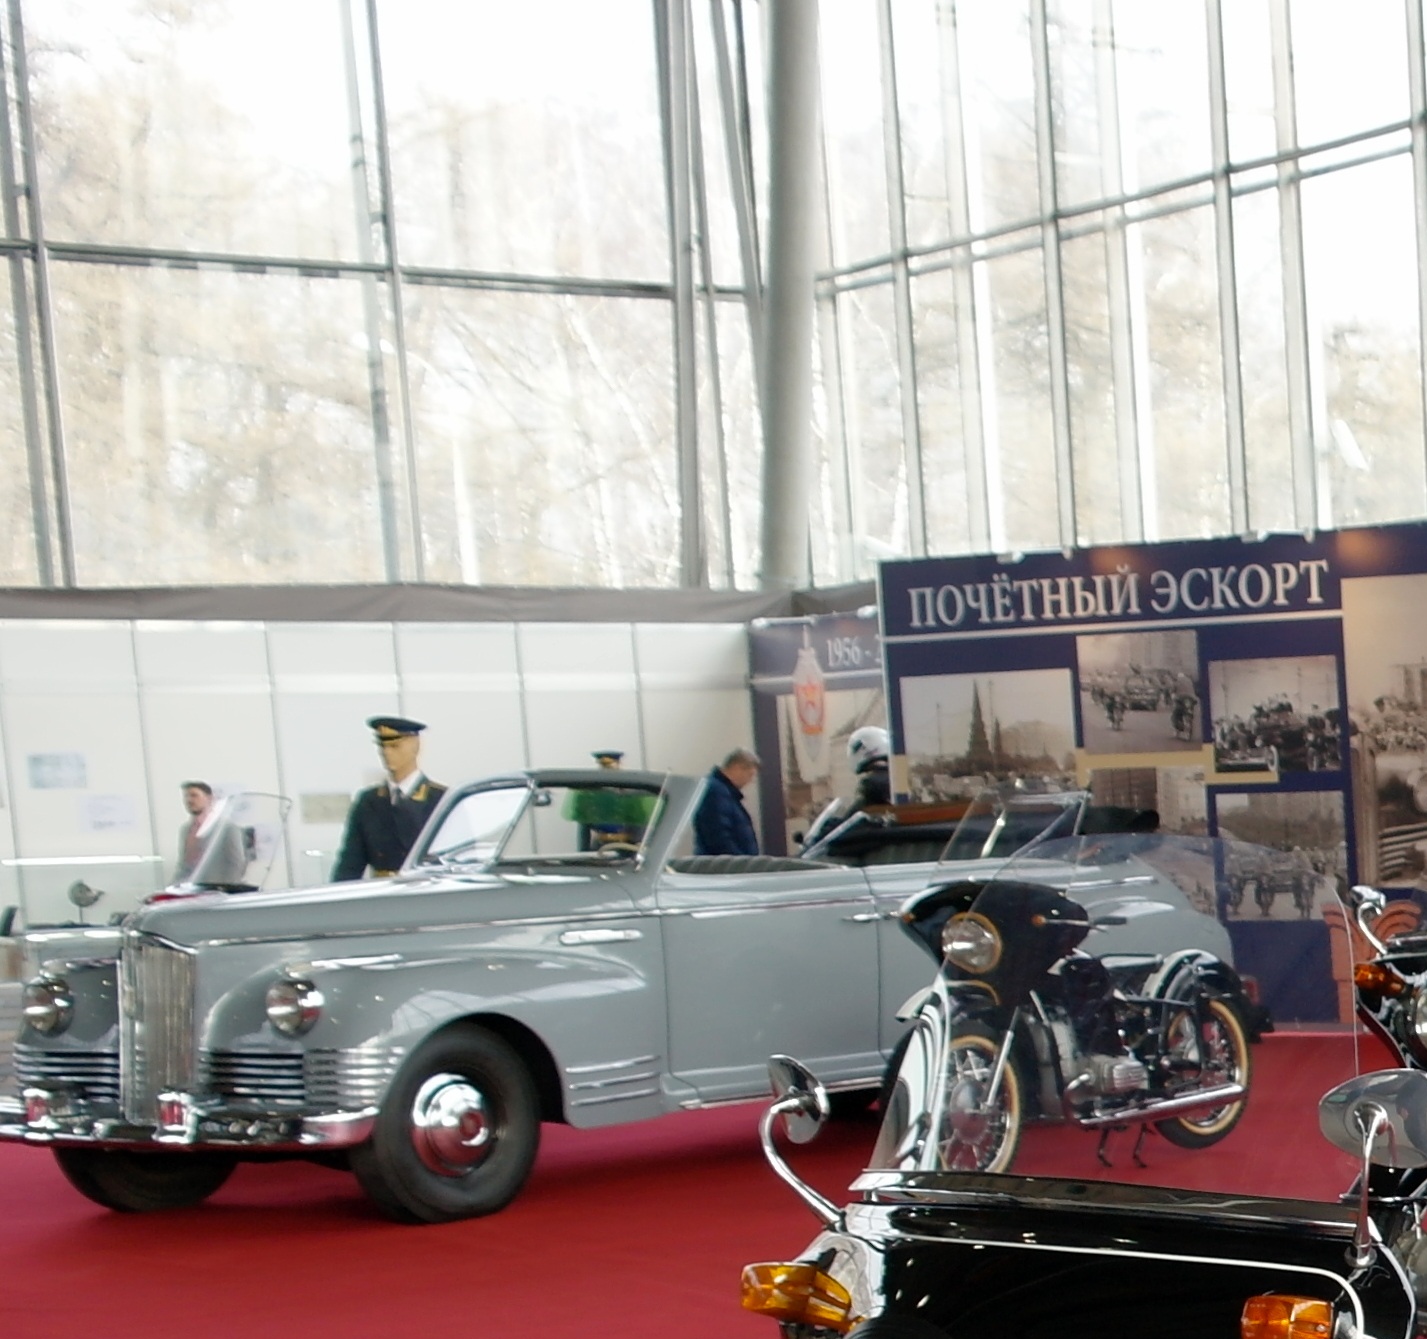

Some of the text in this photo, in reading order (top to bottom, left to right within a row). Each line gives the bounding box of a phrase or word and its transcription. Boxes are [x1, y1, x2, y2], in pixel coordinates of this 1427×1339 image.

[906, 558, 1330, 629] ПОЧЁТНЫЙ ЭСКОРТ
[826, 635, 861, 667] 1956
